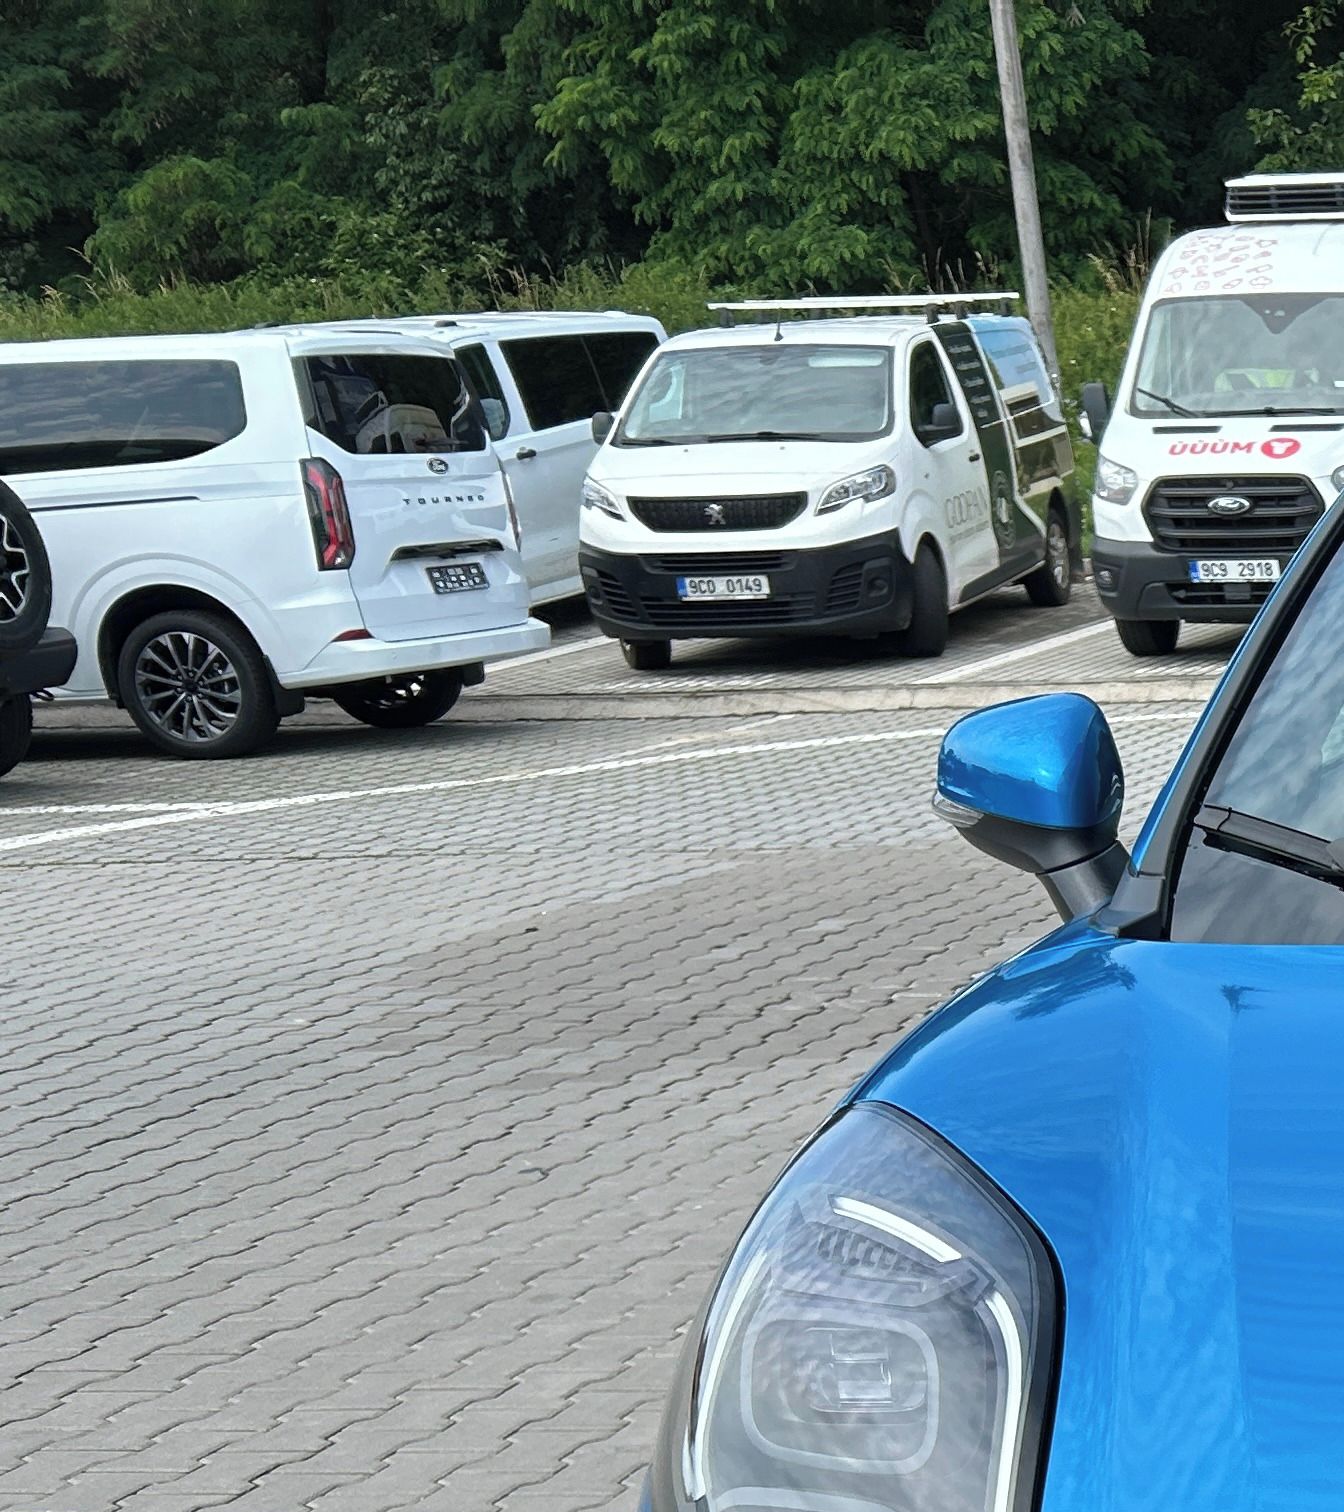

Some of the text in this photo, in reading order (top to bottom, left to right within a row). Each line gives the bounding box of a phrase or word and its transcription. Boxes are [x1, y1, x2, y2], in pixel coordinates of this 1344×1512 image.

[402, 494, 485, 505] TOURNEO
[1238, 562, 1274, 577] 2918
[725, 577, 763, 594] 0149
